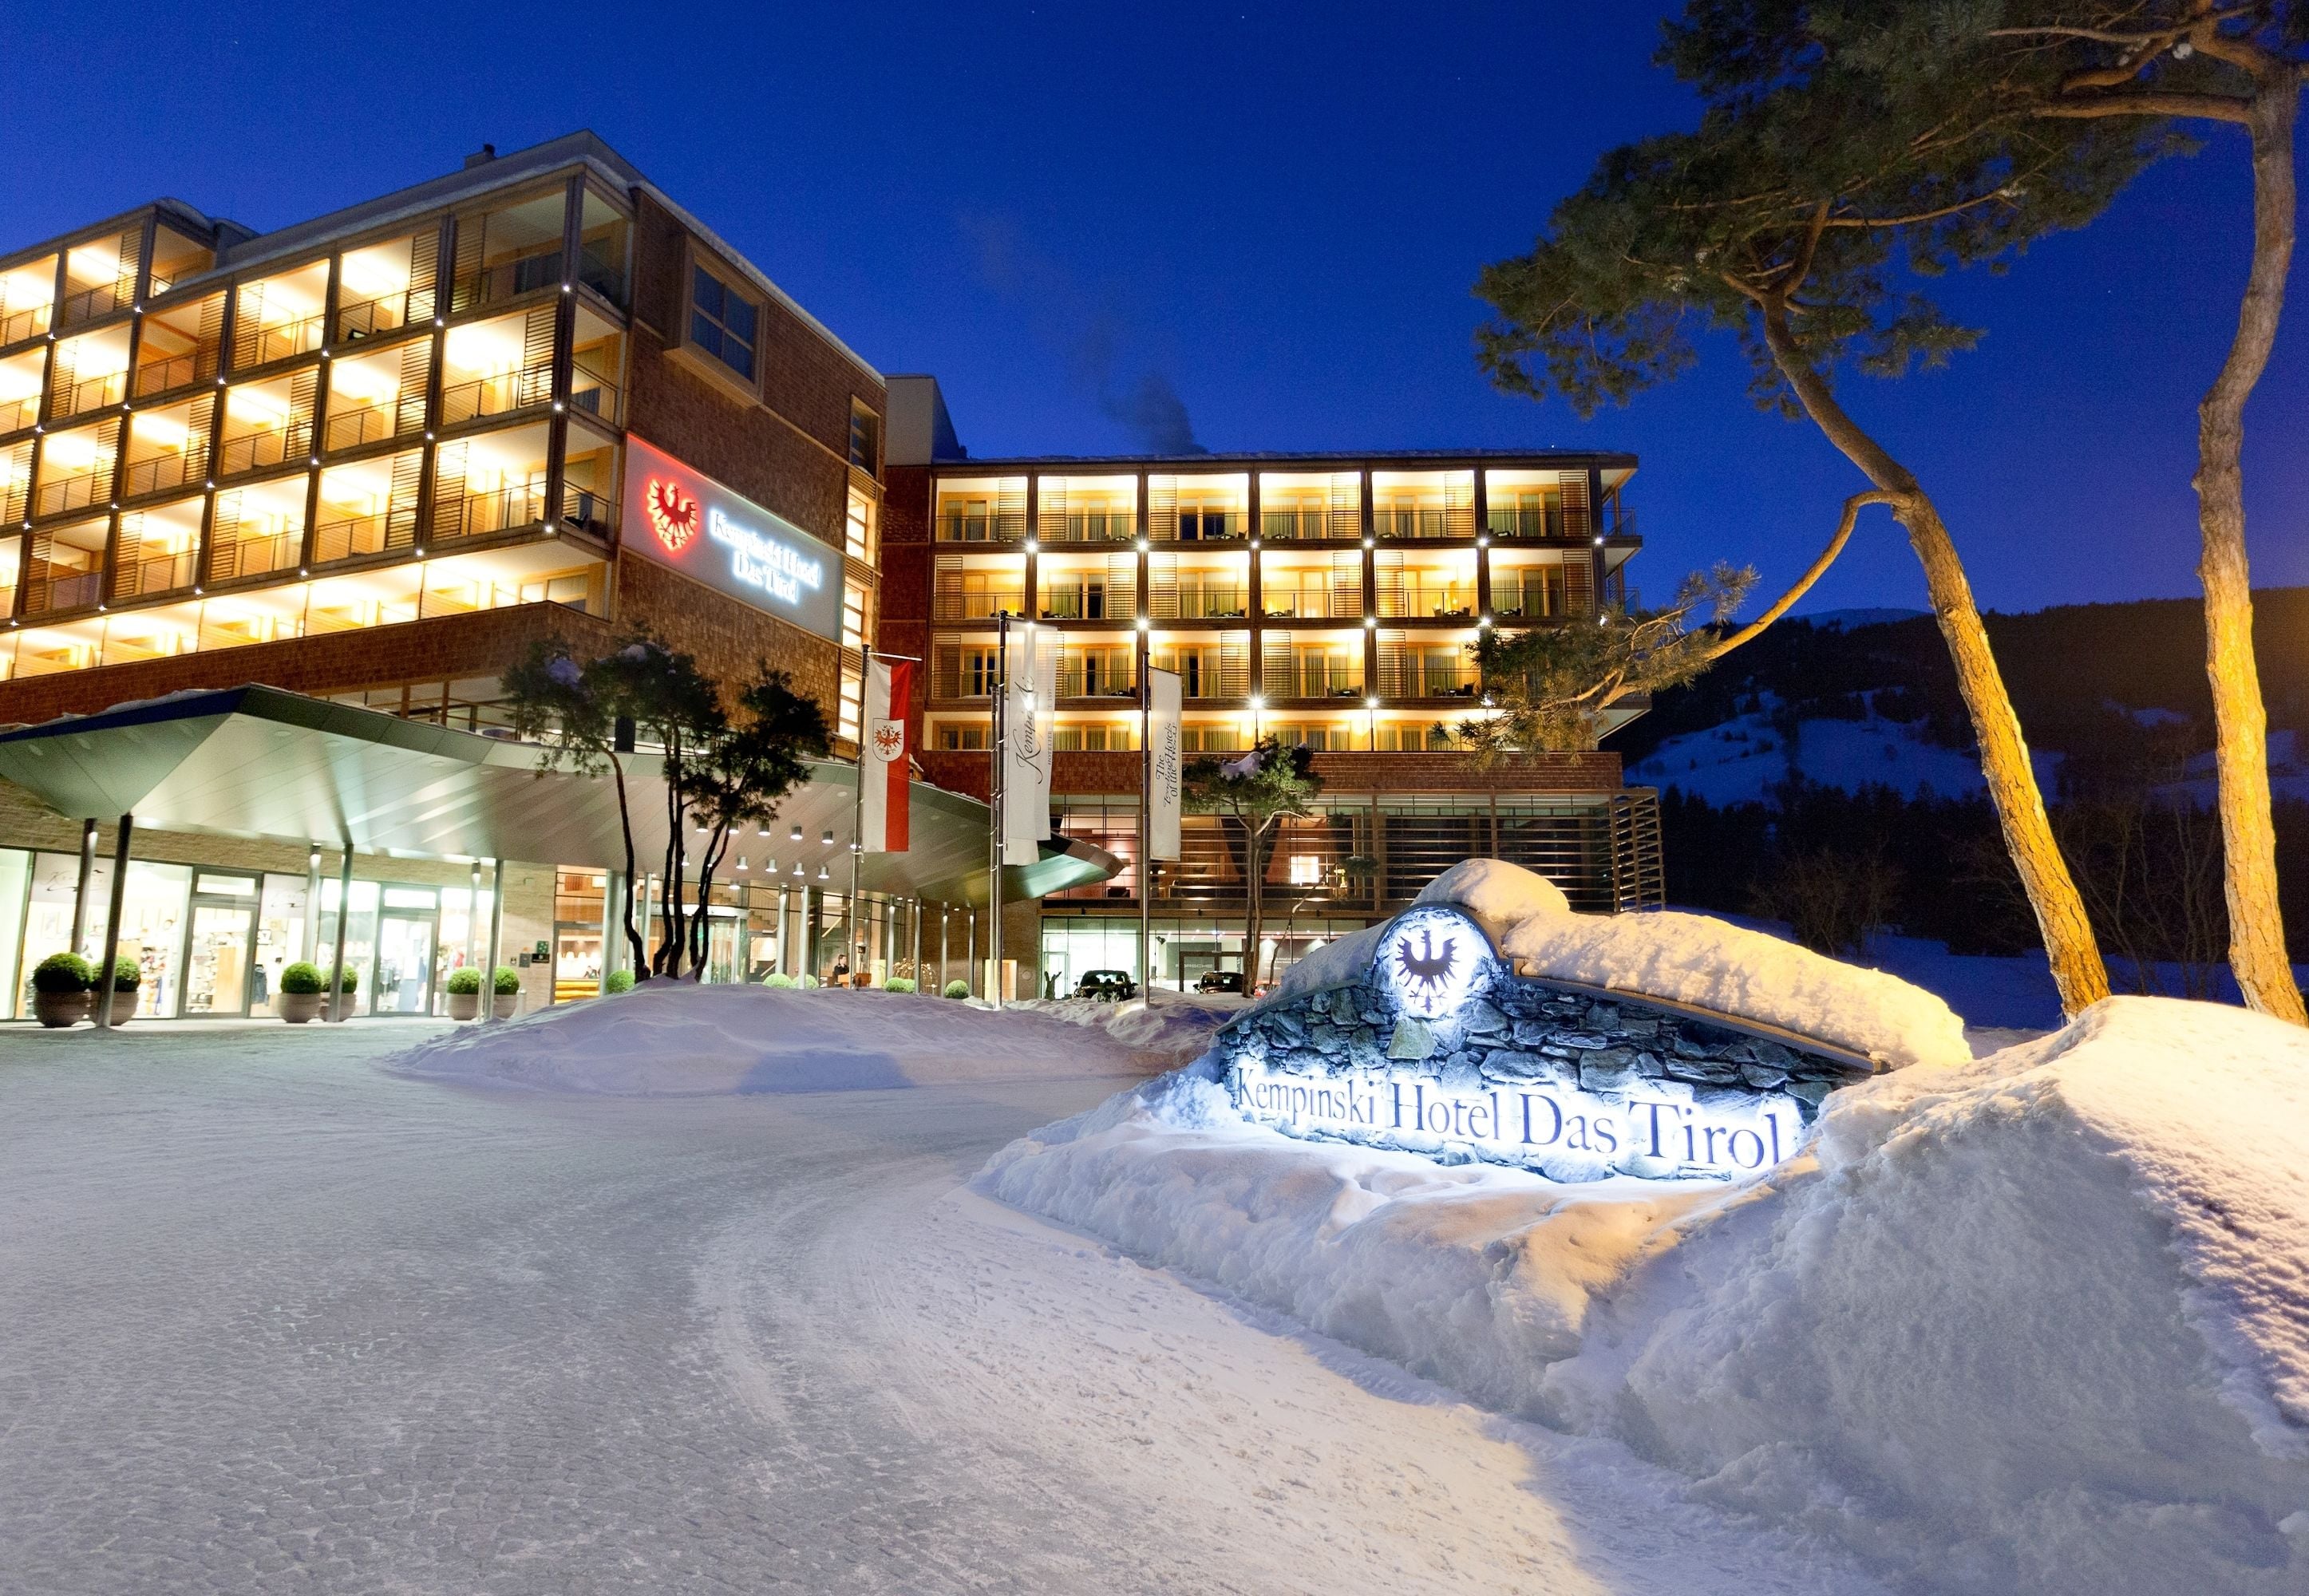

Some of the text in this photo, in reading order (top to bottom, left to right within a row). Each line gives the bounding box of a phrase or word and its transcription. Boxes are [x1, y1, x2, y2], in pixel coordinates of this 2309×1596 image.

[1164, 722, 1173, 762] Hotels
[1156, 754, 1164, 780] The
[1170, 785, 1177, 797] of
[1237, 1068, 1779, 1168] Kempinski Hotel Das Tirol
